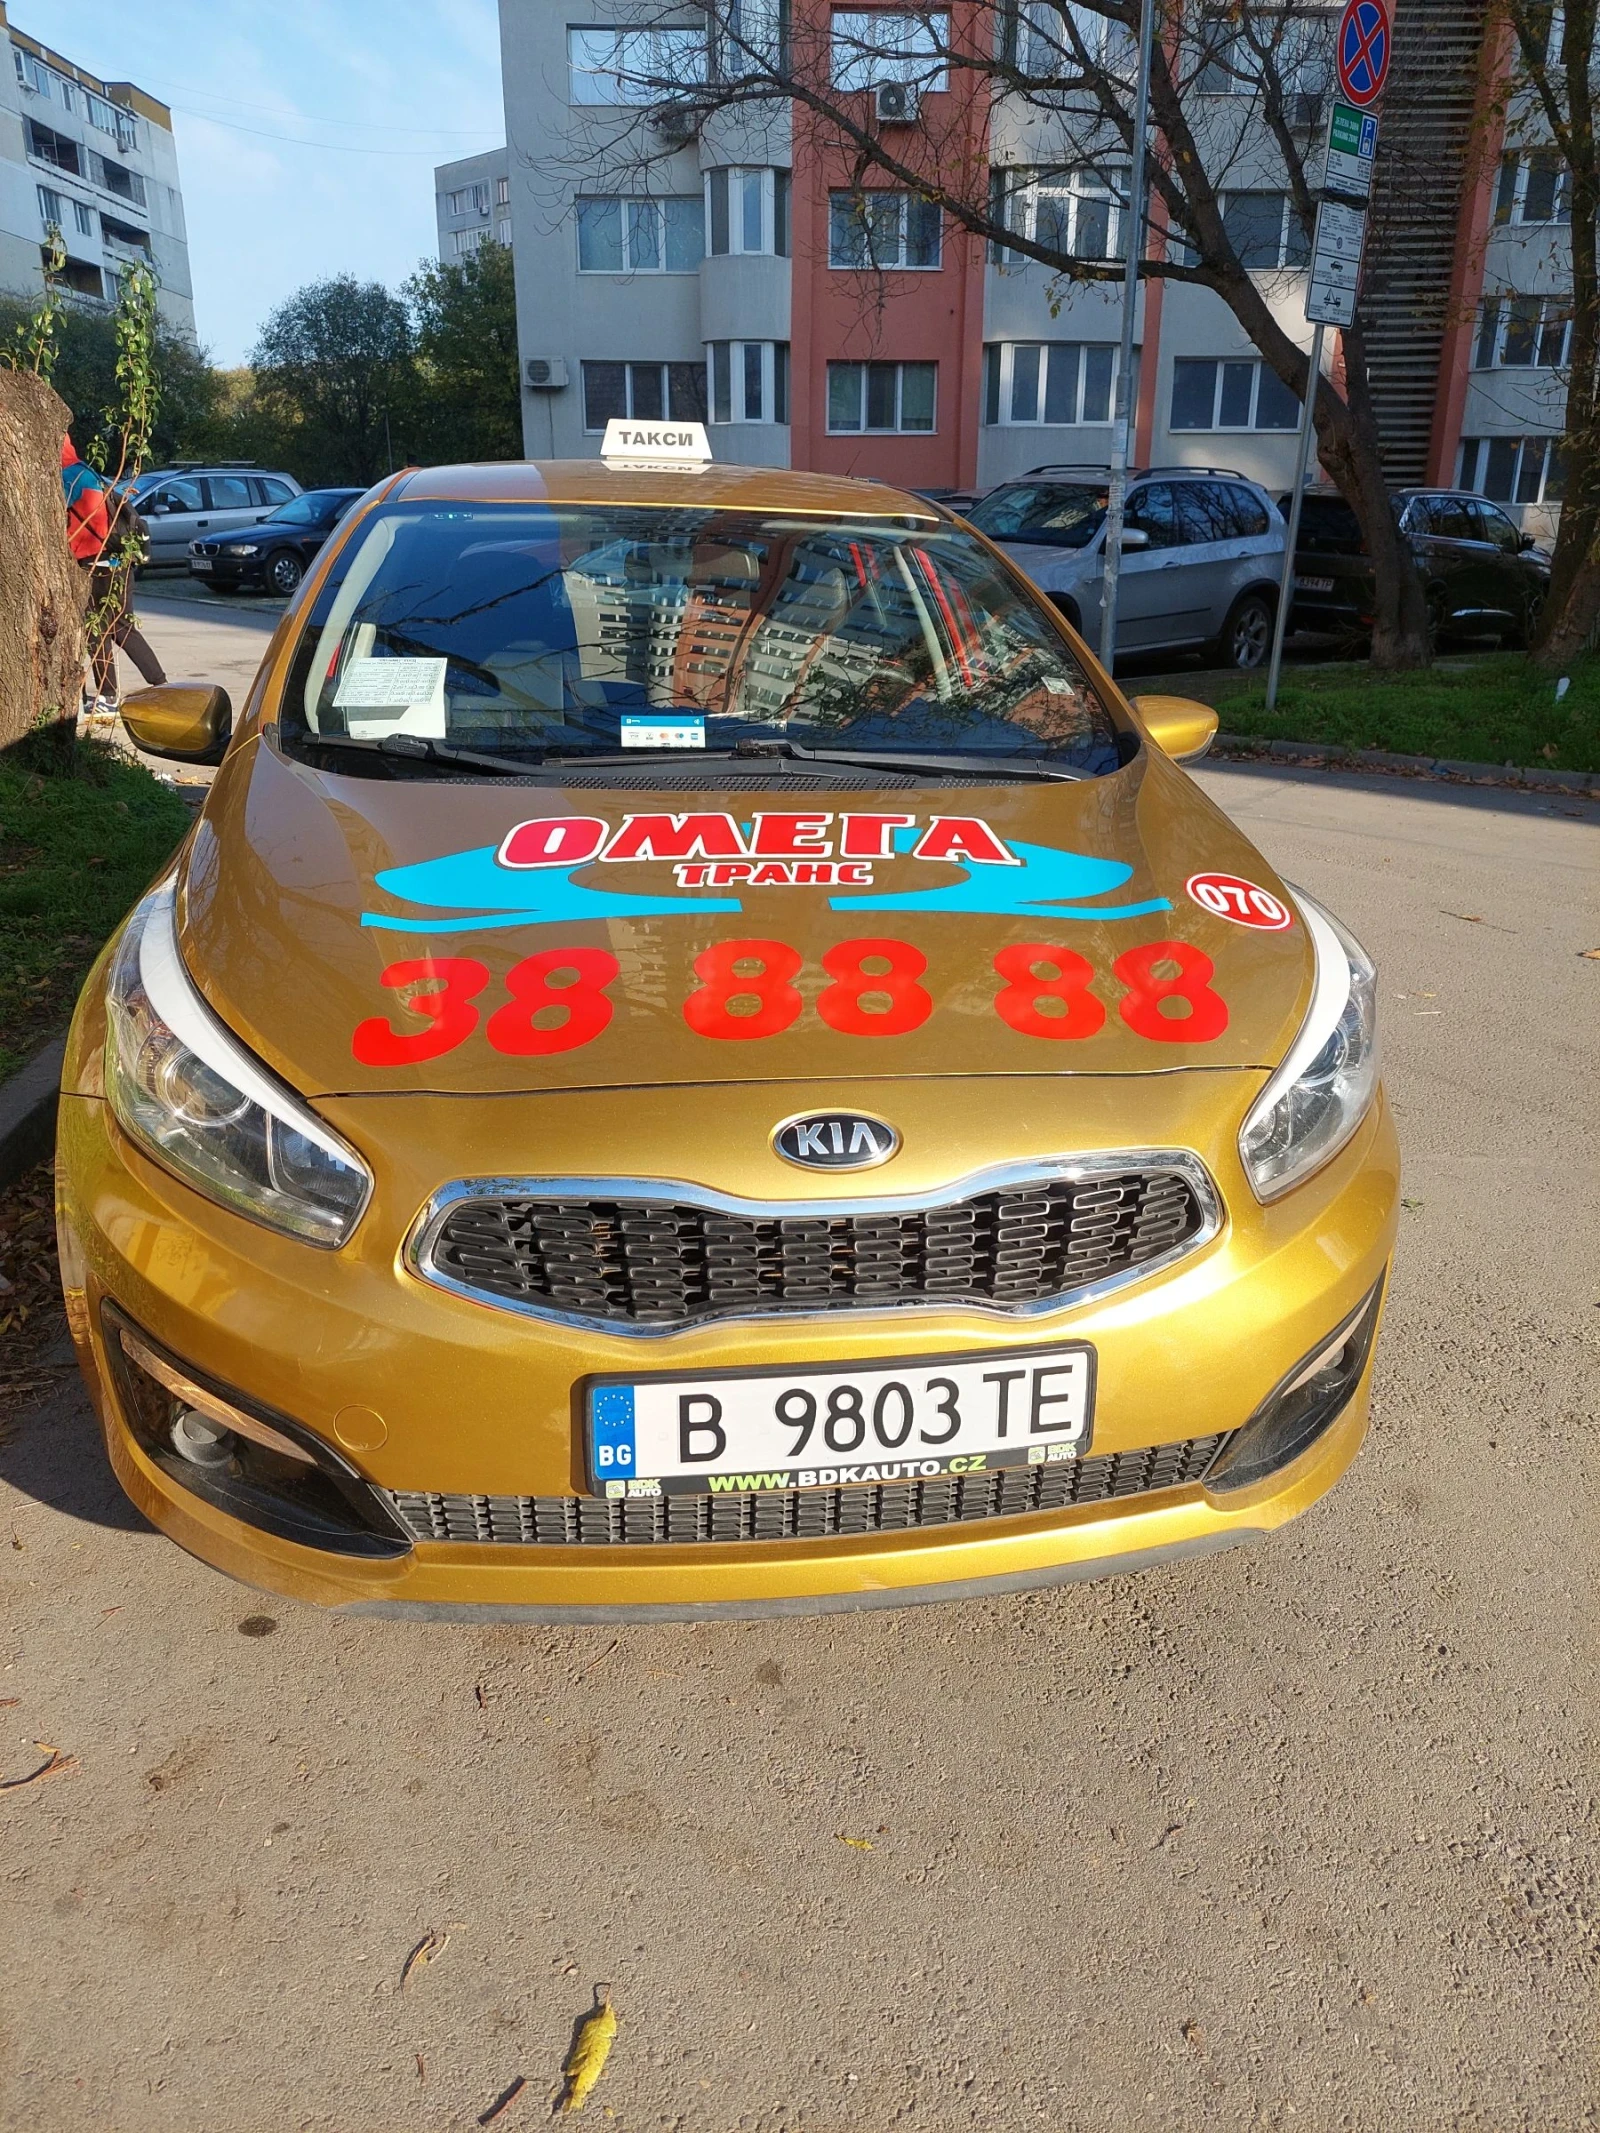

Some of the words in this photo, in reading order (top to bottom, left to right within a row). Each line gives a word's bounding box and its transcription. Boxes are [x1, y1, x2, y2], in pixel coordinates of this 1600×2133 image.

[1365, 121, 1372, 136] P
[618, 431, 693, 447] ТАКСИ
[498, 812, 1022, 868] ОМЕГА
[673, 861, 874, 887] ТРАНС
[1196, 883, 1282, 920] 070
[352, 947, 621, 1067] 38
[683, 937, 934, 1041] 88
[993, 940, 1230, 1044] 88
[795, 1122, 881, 1156] KIA
[678, 1394, 727, 1464] B
[773, 1377, 963, 1458] 9803
[982, 1364, 1074, 1438] TE
[598, 1444, 632, 1466] BG
[1046, 1451, 1077, 1462] AUTO
[1047, 1442, 1077, 1455] BDK
[627, 1479, 661, 1490] BDK
[627, 1488, 662, 1498] AUTO
